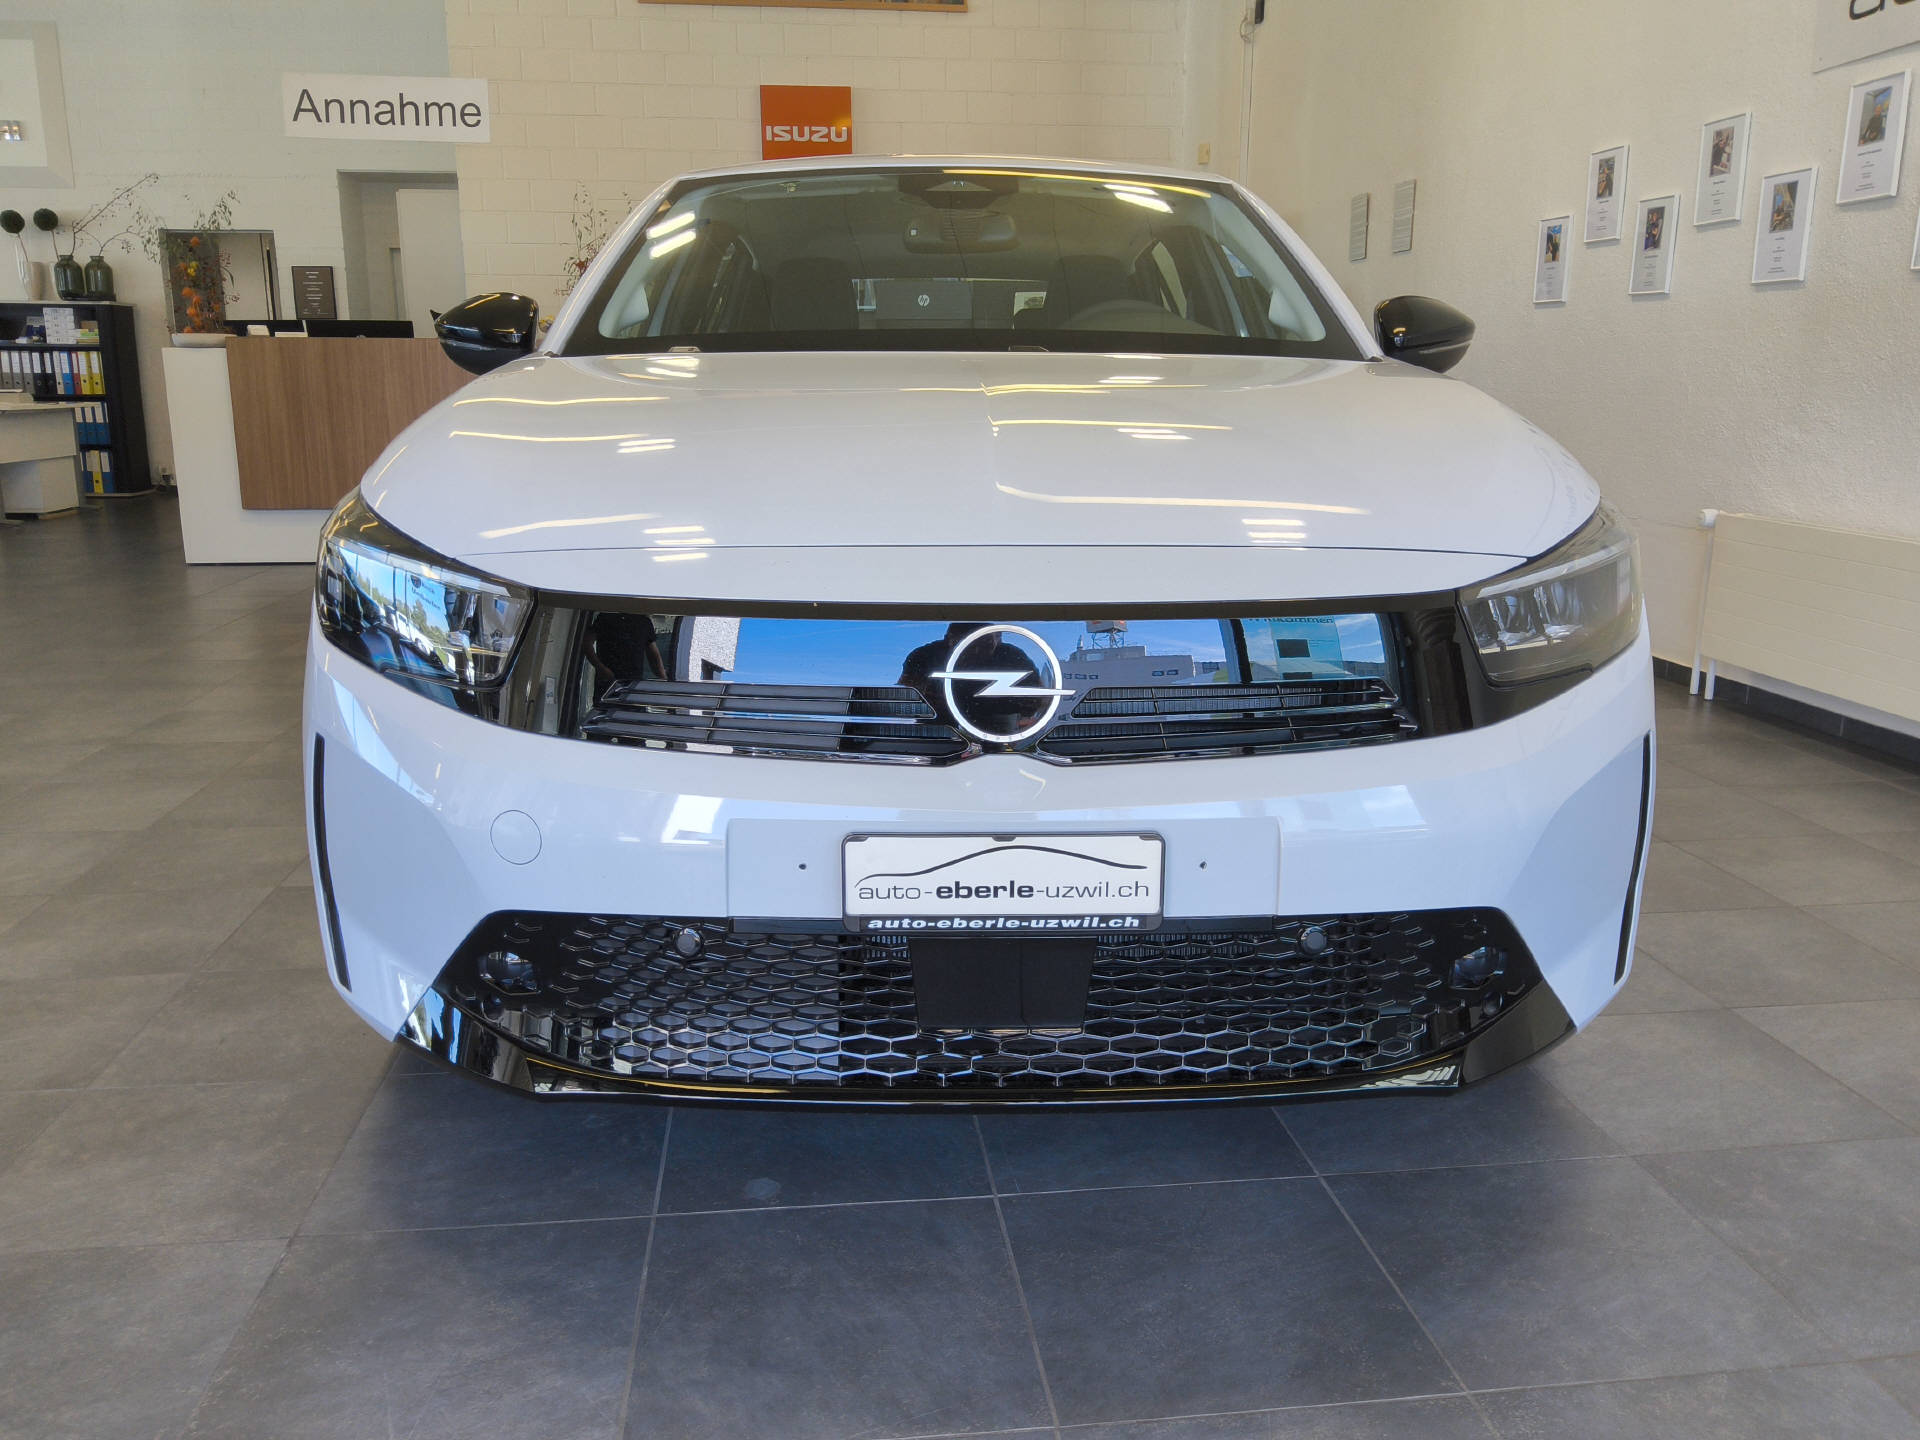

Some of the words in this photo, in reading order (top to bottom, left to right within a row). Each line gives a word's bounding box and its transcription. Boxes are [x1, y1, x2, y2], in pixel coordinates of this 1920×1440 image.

[292, 88, 482, 128] Annahme
[765, 125, 848, 143] ISUZU
[858, 880, 1150, 901] auto-eberle-uzwil.ch
[868, 915, 1140, 930] auto-eberle-uzwil.ch
